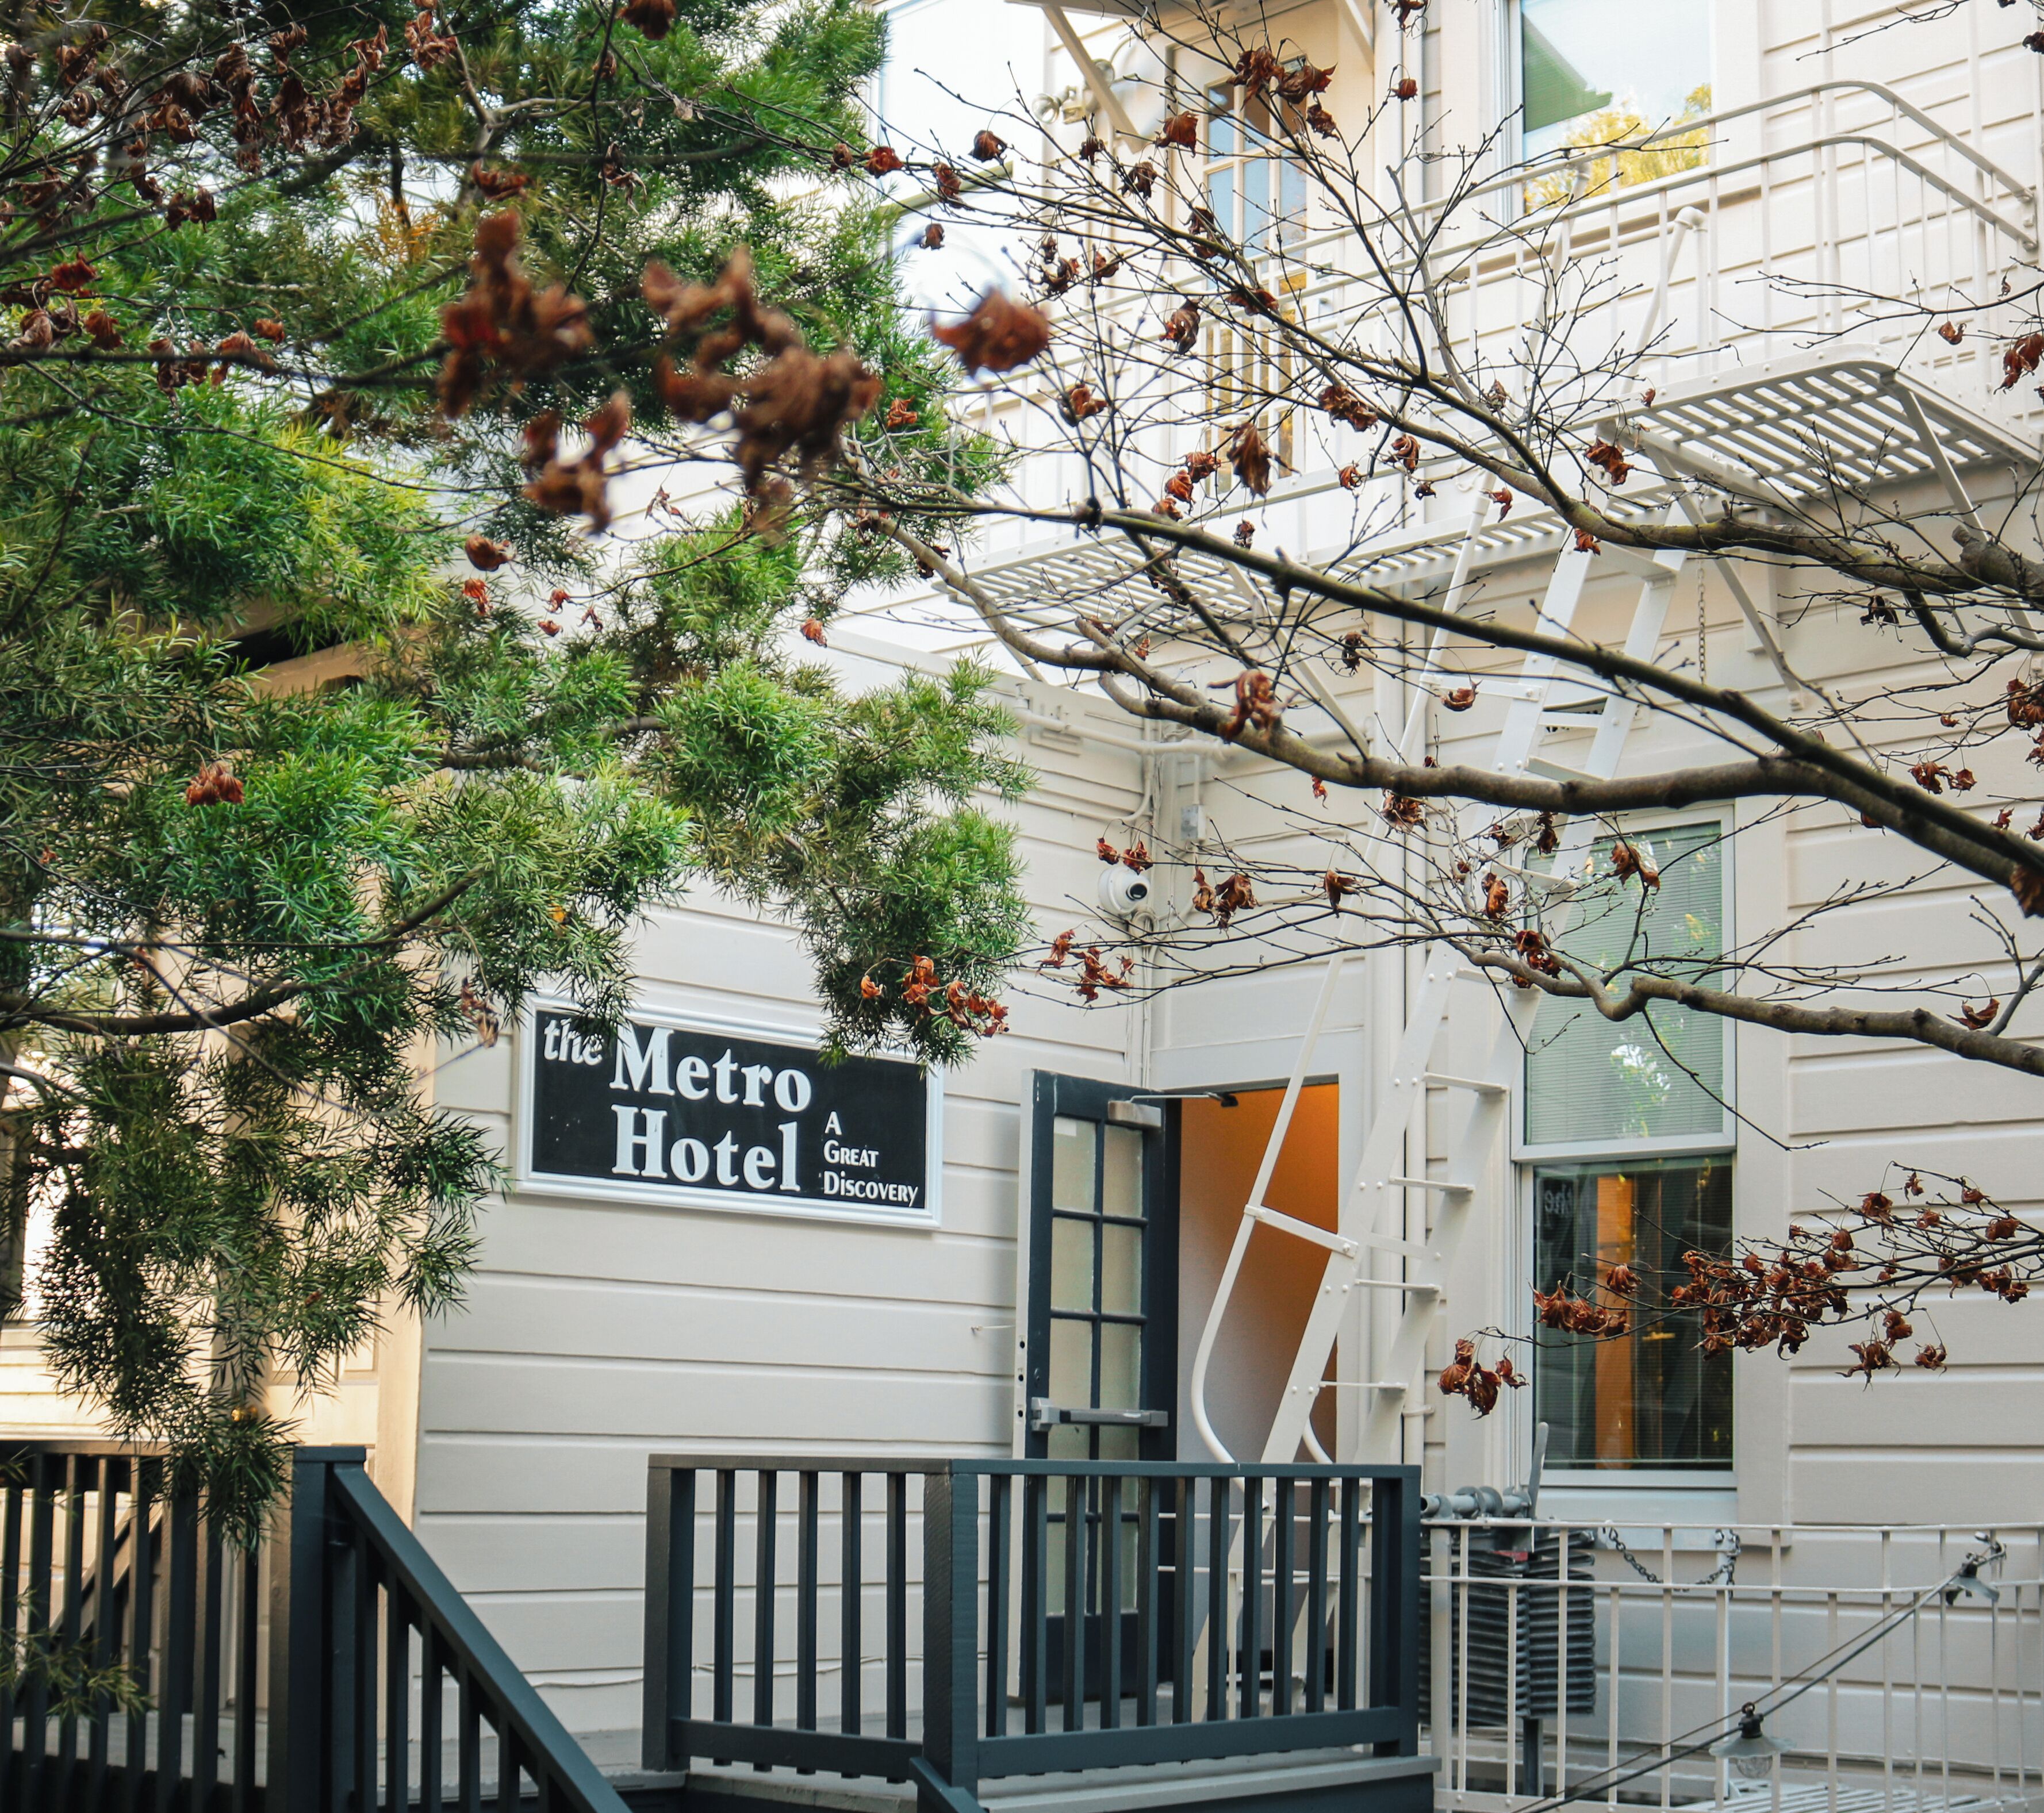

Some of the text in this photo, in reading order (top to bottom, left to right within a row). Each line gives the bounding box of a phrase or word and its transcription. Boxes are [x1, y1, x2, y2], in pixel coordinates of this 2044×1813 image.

[544, 1017, 812, 1113] the Metro
[611, 1104, 801, 1192] Hotel
[824, 1111, 842, 1135] A
[823, 1139, 879, 1168] GREAT
